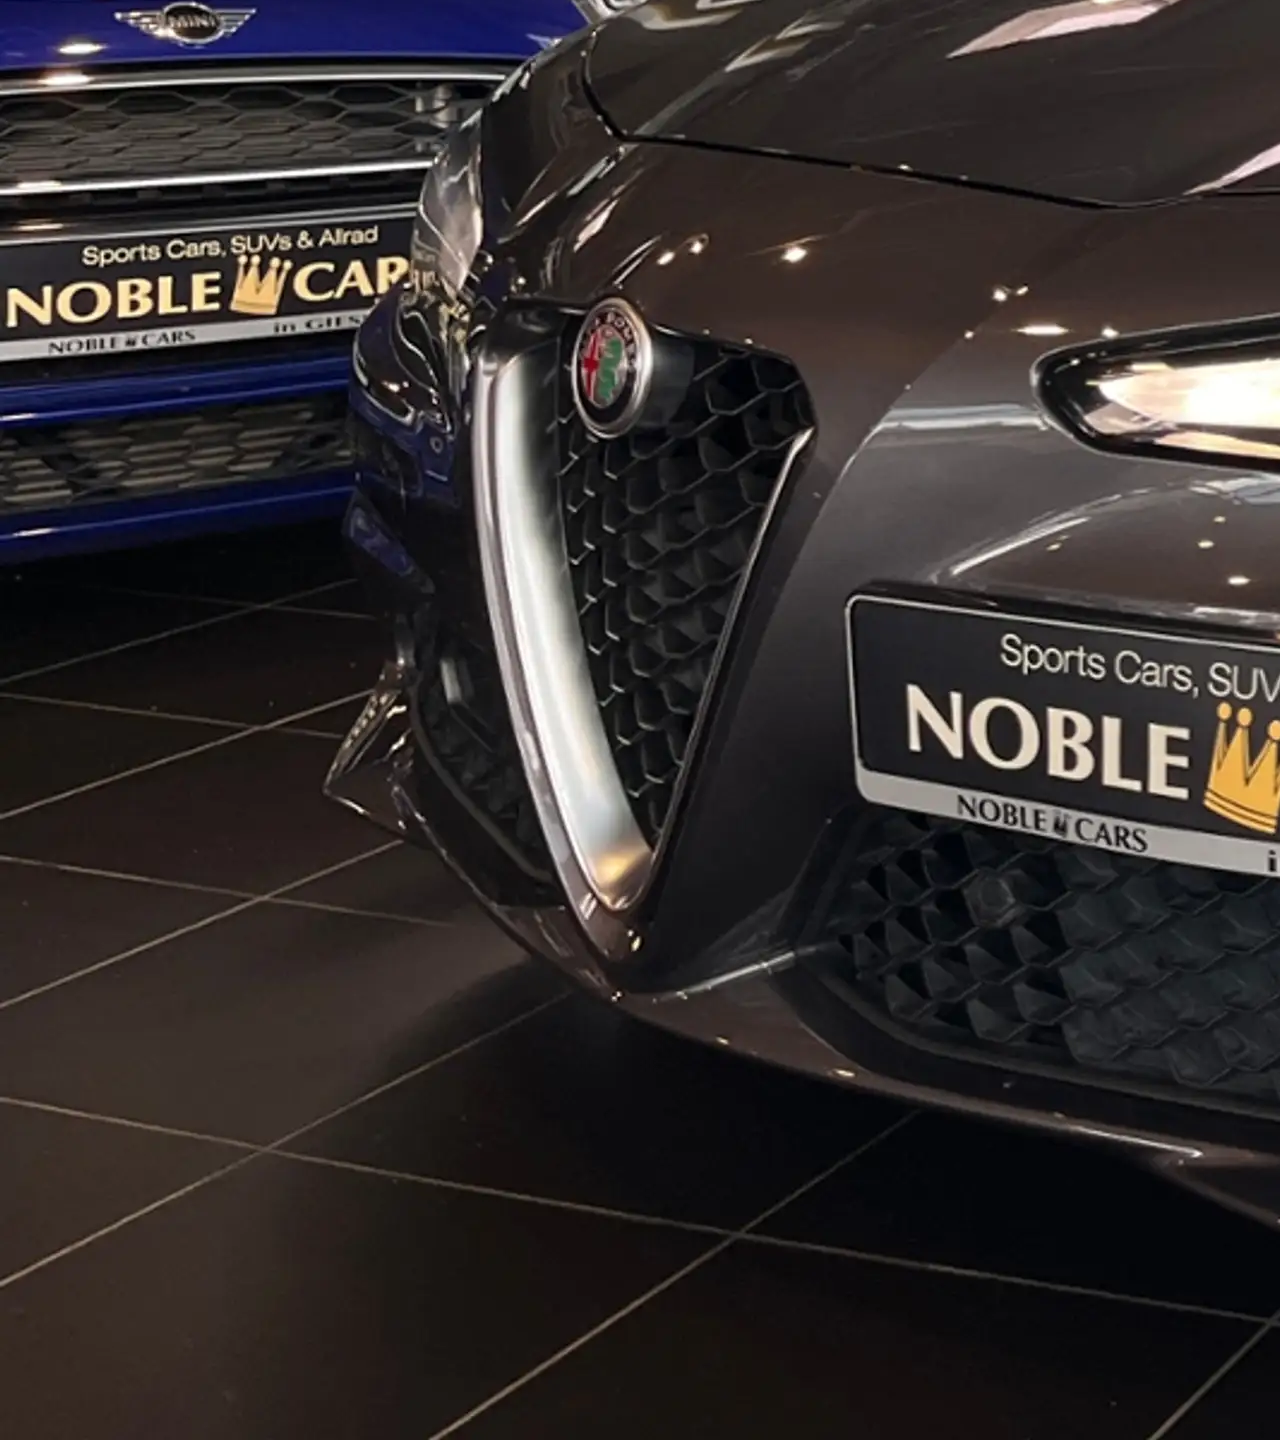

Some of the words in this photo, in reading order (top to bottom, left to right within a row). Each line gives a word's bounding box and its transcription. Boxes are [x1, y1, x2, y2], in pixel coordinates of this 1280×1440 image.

[82, 244, 161, 267] Sports
[167, 238, 227, 259] Cars,
[230, 231, 292, 255] SUVs
[297, 228, 314, 248] &
[318, 226, 379, 247] Allrad
[6, 270, 221, 328] NOBLE
[293, 256, 410, 303] CAR
[49, 337, 119, 355] NOBLE
[142, 329, 196, 345] CARS
[1000, 633, 1107, 680] Sports
[1114, 650, 1199, 698] Cars,
[905, 683, 1191, 801] NOBLE
[957, 793, 1048, 832] NOBLE
[1075, 817, 1149, 852] CARS
